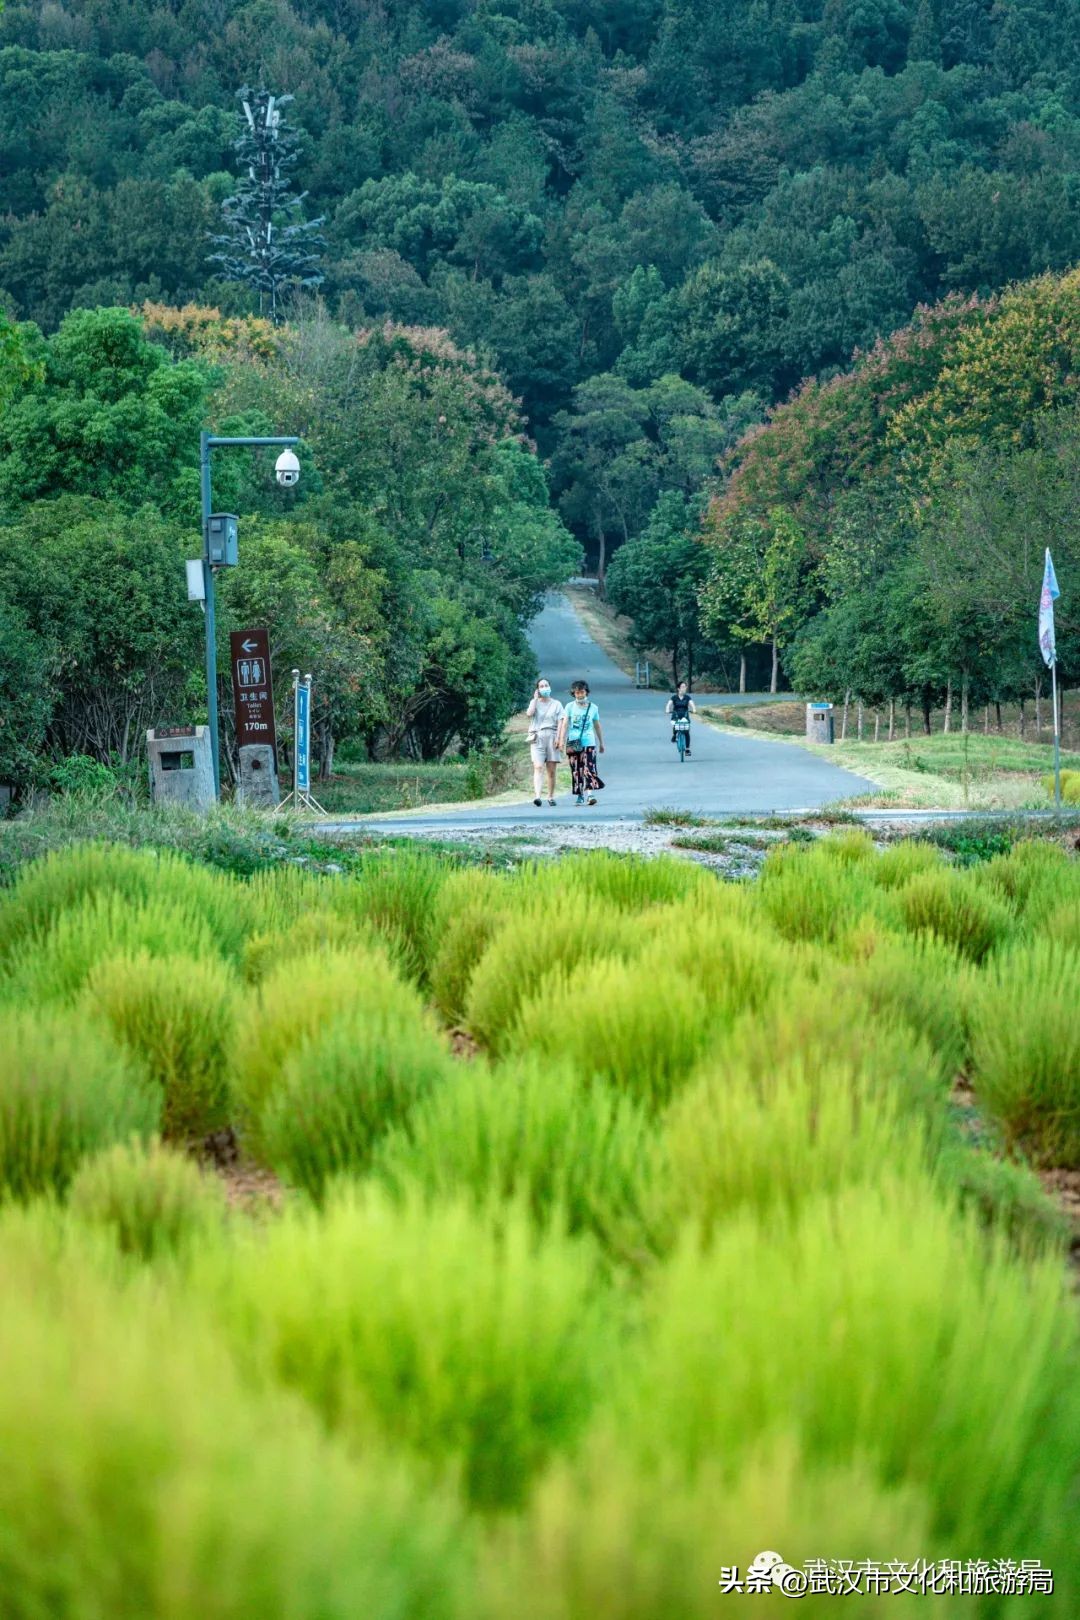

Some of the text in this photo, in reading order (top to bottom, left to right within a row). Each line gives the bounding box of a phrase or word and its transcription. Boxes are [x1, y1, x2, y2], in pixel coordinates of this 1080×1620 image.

[240, 692, 267, 701] 卫生间
[244, 722, 268, 731] 170m
